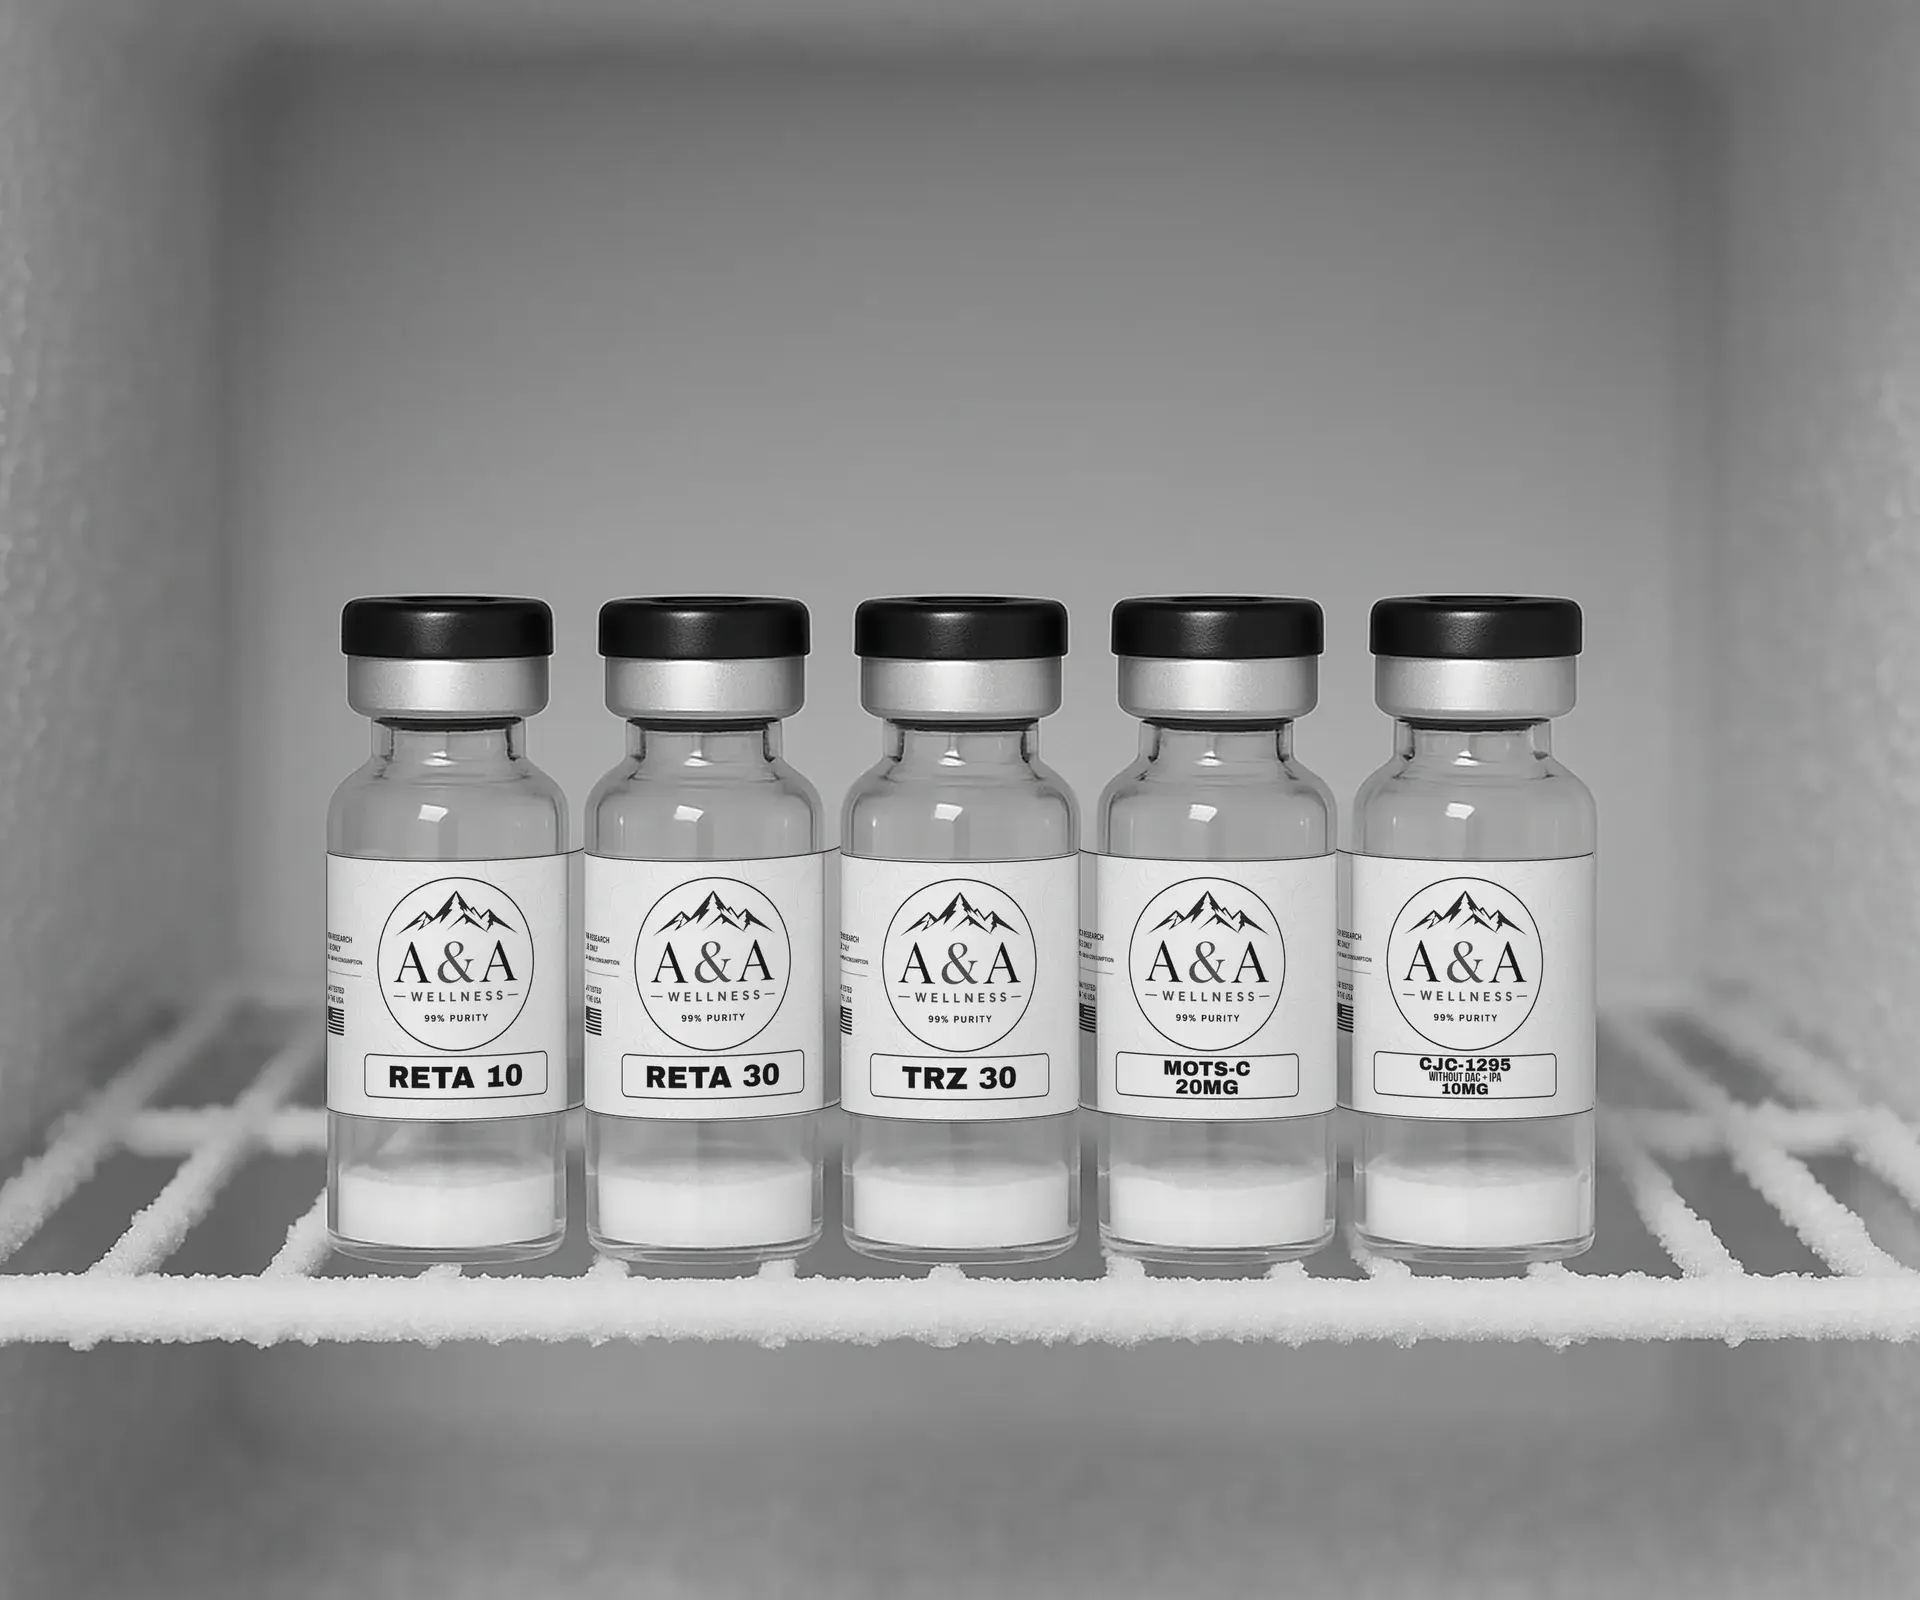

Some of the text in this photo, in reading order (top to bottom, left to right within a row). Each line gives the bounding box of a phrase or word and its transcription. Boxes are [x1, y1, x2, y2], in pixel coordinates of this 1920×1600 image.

[410, 989, 504, 1003] WELLNESS
[667, 989, 761, 1003] WELLNESS
[914, 991, 1007, 1004] WELLNESS
[1162, 990, 1255, 1003] WELLNESS
[1419, 990, 1513, 1002] WELLNESS
[424, 1013, 489, 1023] 99% PURITY
[681, 1012, 746, 1023] 99% PURITY
[928, 1014, 992, 1024] 99% PURITY
[1175, 1013, 1240, 1023] 99% PURITY
[1433, 1013, 1498, 1023] 99% PURITY
[1163, 1059, 1251, 1077] MOTS-C
[1419, 1055, 1513, 1072] CJC-1295
[389, 1063, 523, 1089] RETA 10
[646, 1062, 780, 1089] RETA 30
[901, 1065, 1017, 1090] TRZ 30
[1429, 1071, 1463, 1083] WITHOUT
[1465, 1072, 1481, 1083] DAC
[1489, 1073, 1502, 1083] IPA
[1175, 1078, 1239, 1096] 20MG
[1441, 1082, 1489, 1096] 10MG
